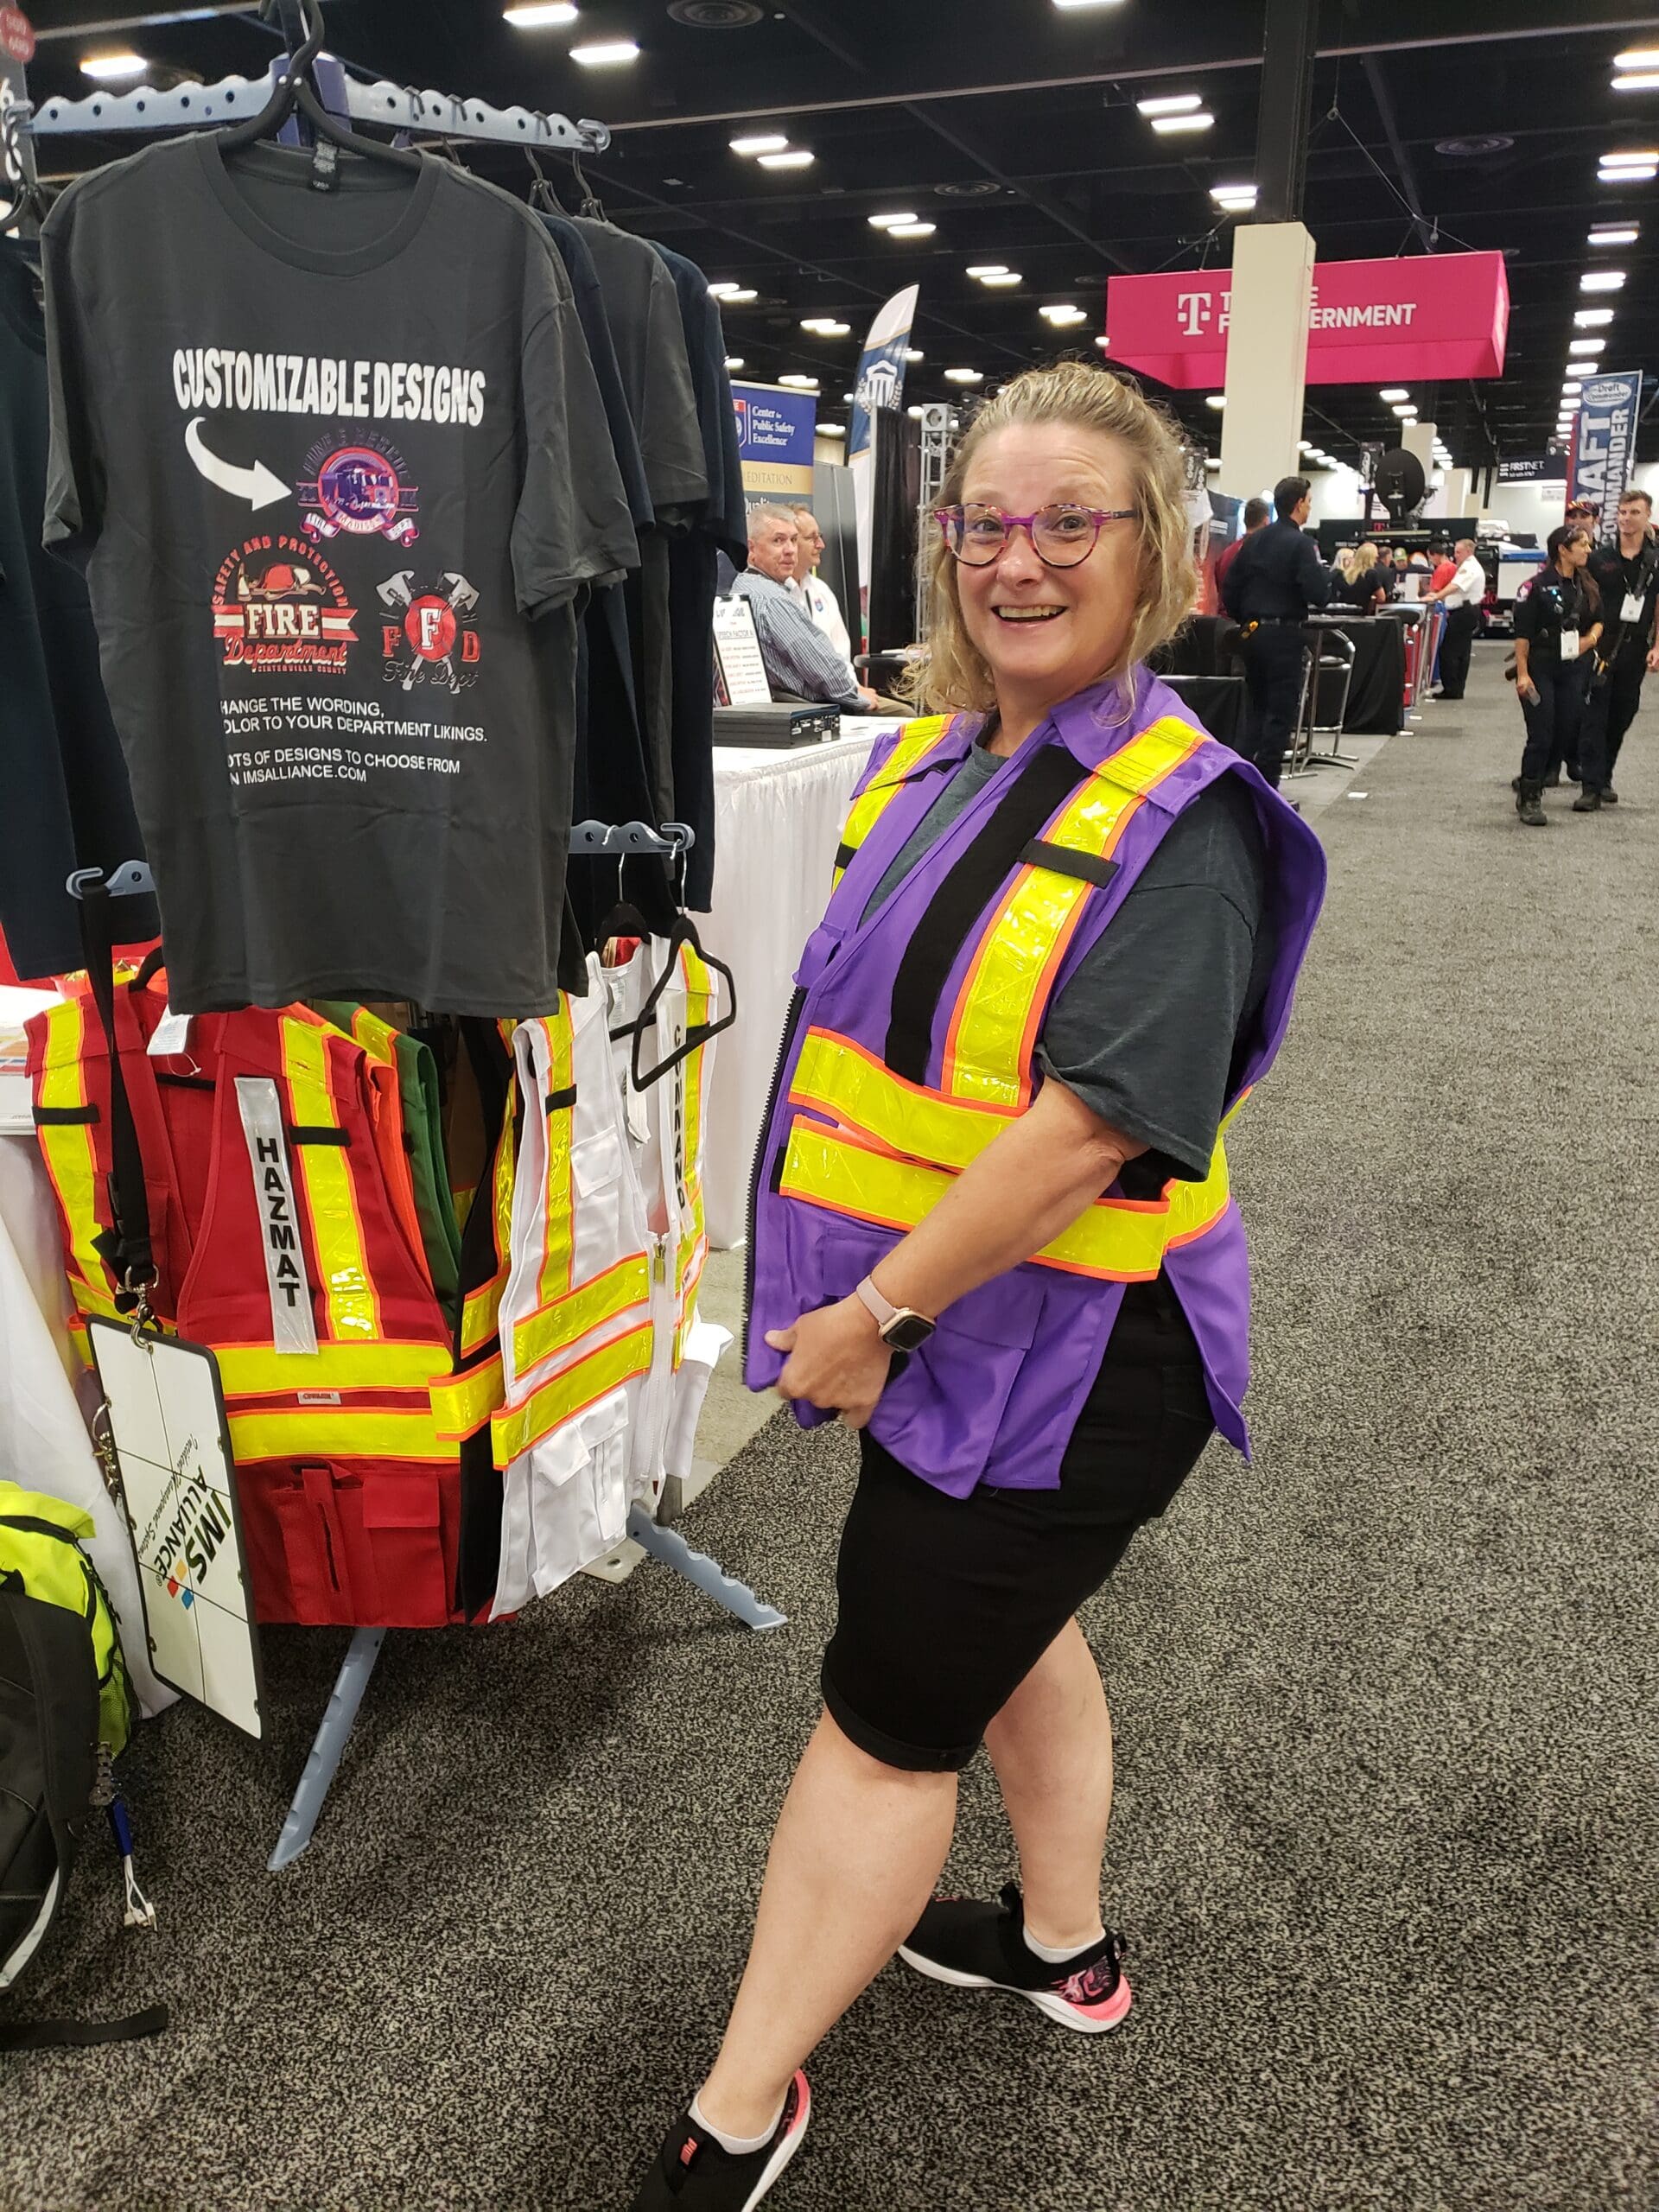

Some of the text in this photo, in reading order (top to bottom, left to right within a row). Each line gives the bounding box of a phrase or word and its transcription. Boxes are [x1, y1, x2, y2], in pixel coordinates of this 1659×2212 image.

[1309, 303, 1417, 329] ERNMENT
[174, 347, 486, 427] CUSTOMIZABLE DESIGNS
[752, 406, 775, 418] Center
[753, 420, 795, 436] Public Safety
[753, 434, 788, 446] Excellence
[747, 471, 792, 485] EDITATION
[1576, 410, 1611, 523] RAFT
[212, 535, 349, 607] SAFETY AND PROTECTION
[246, 603, 321, 639] FIRE
[382, 607, 480, 663] F F D
[223, 634, 347, 673] Department
[317, 665, 346, 675] COUNTY
[220, 696, 385, 718] HANGE THE WORDING,
[223, 715, 488, 742] OLOR TO YOUR DEPARTMENT LIKINGS.
[227, 747, 461, 774] OTS OF DESIGNS TO CHOOSE FROM
[230, 764, 367, 786] N IMSALLIANCE.COM
[256, 1136, 301, 1307] HAZMAT
[185, 1490, 232, 1585] IMS
